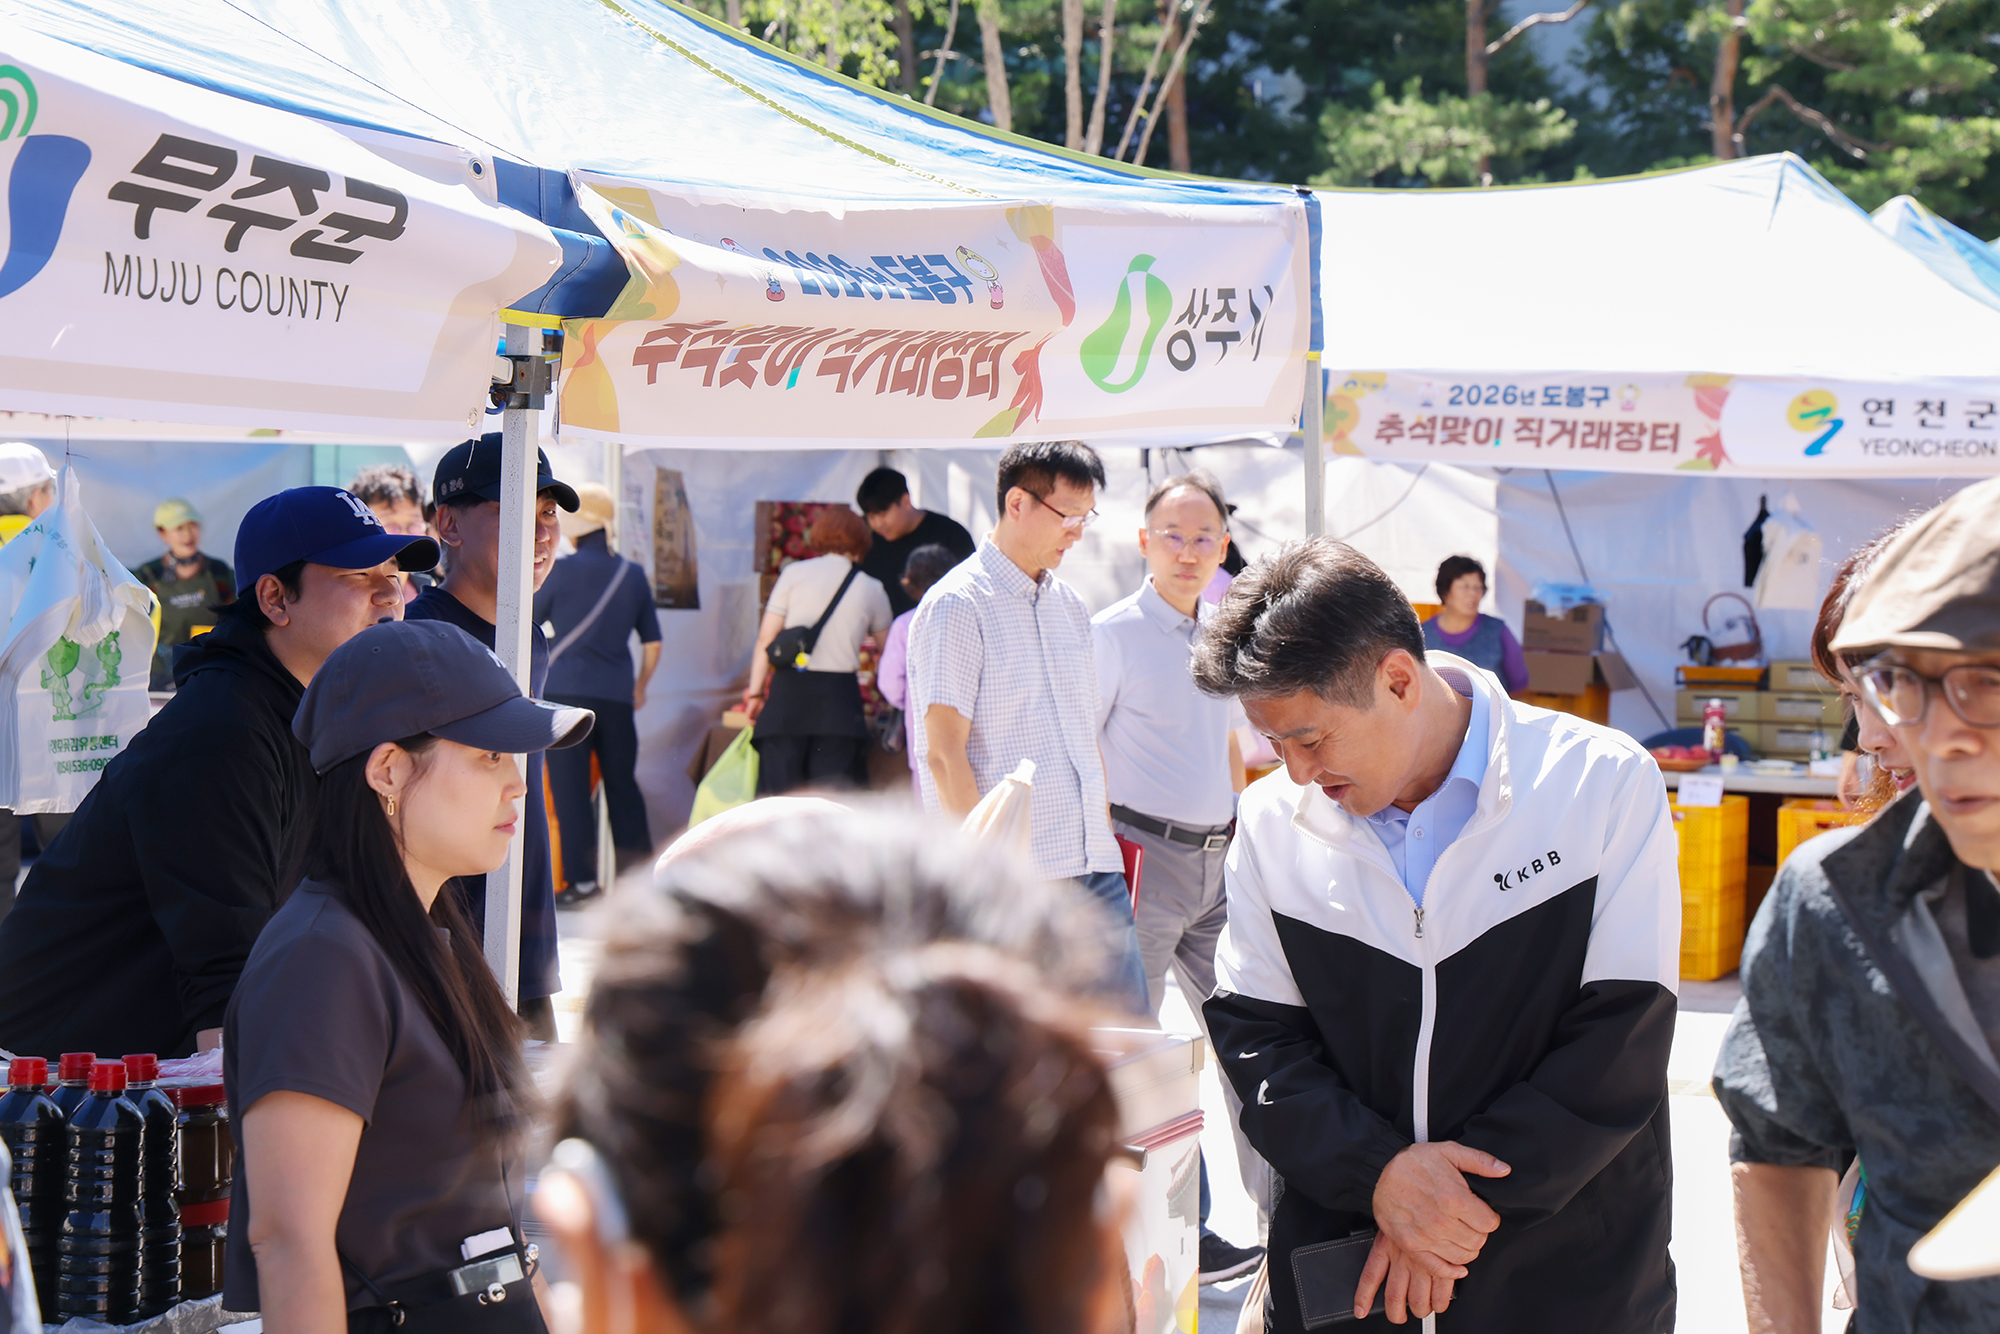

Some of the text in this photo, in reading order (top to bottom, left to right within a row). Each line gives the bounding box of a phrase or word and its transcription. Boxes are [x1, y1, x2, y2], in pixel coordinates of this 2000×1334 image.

[107, 133, 409, 264] 무주군
[103, 251, 350, 323] MUJU COUNTY
[870, 254, 974, 305] 도봉구
[1166, 285, 1274, 372] 상주시
[632, 319, 1032, 401] 추석맞이 직거래장터
[1448, 385, 1611, 408] 2026년 도봉구
[1862, 398, 1997, 430] 연천군
[1374, 414, 1681, 453] 추석맞이 직거래장터
[1860, 437, 1998, 457] YEONCHEON
[72, 757, 113, 773] 536-090
[1516, 850, 1562, 883] KBB
